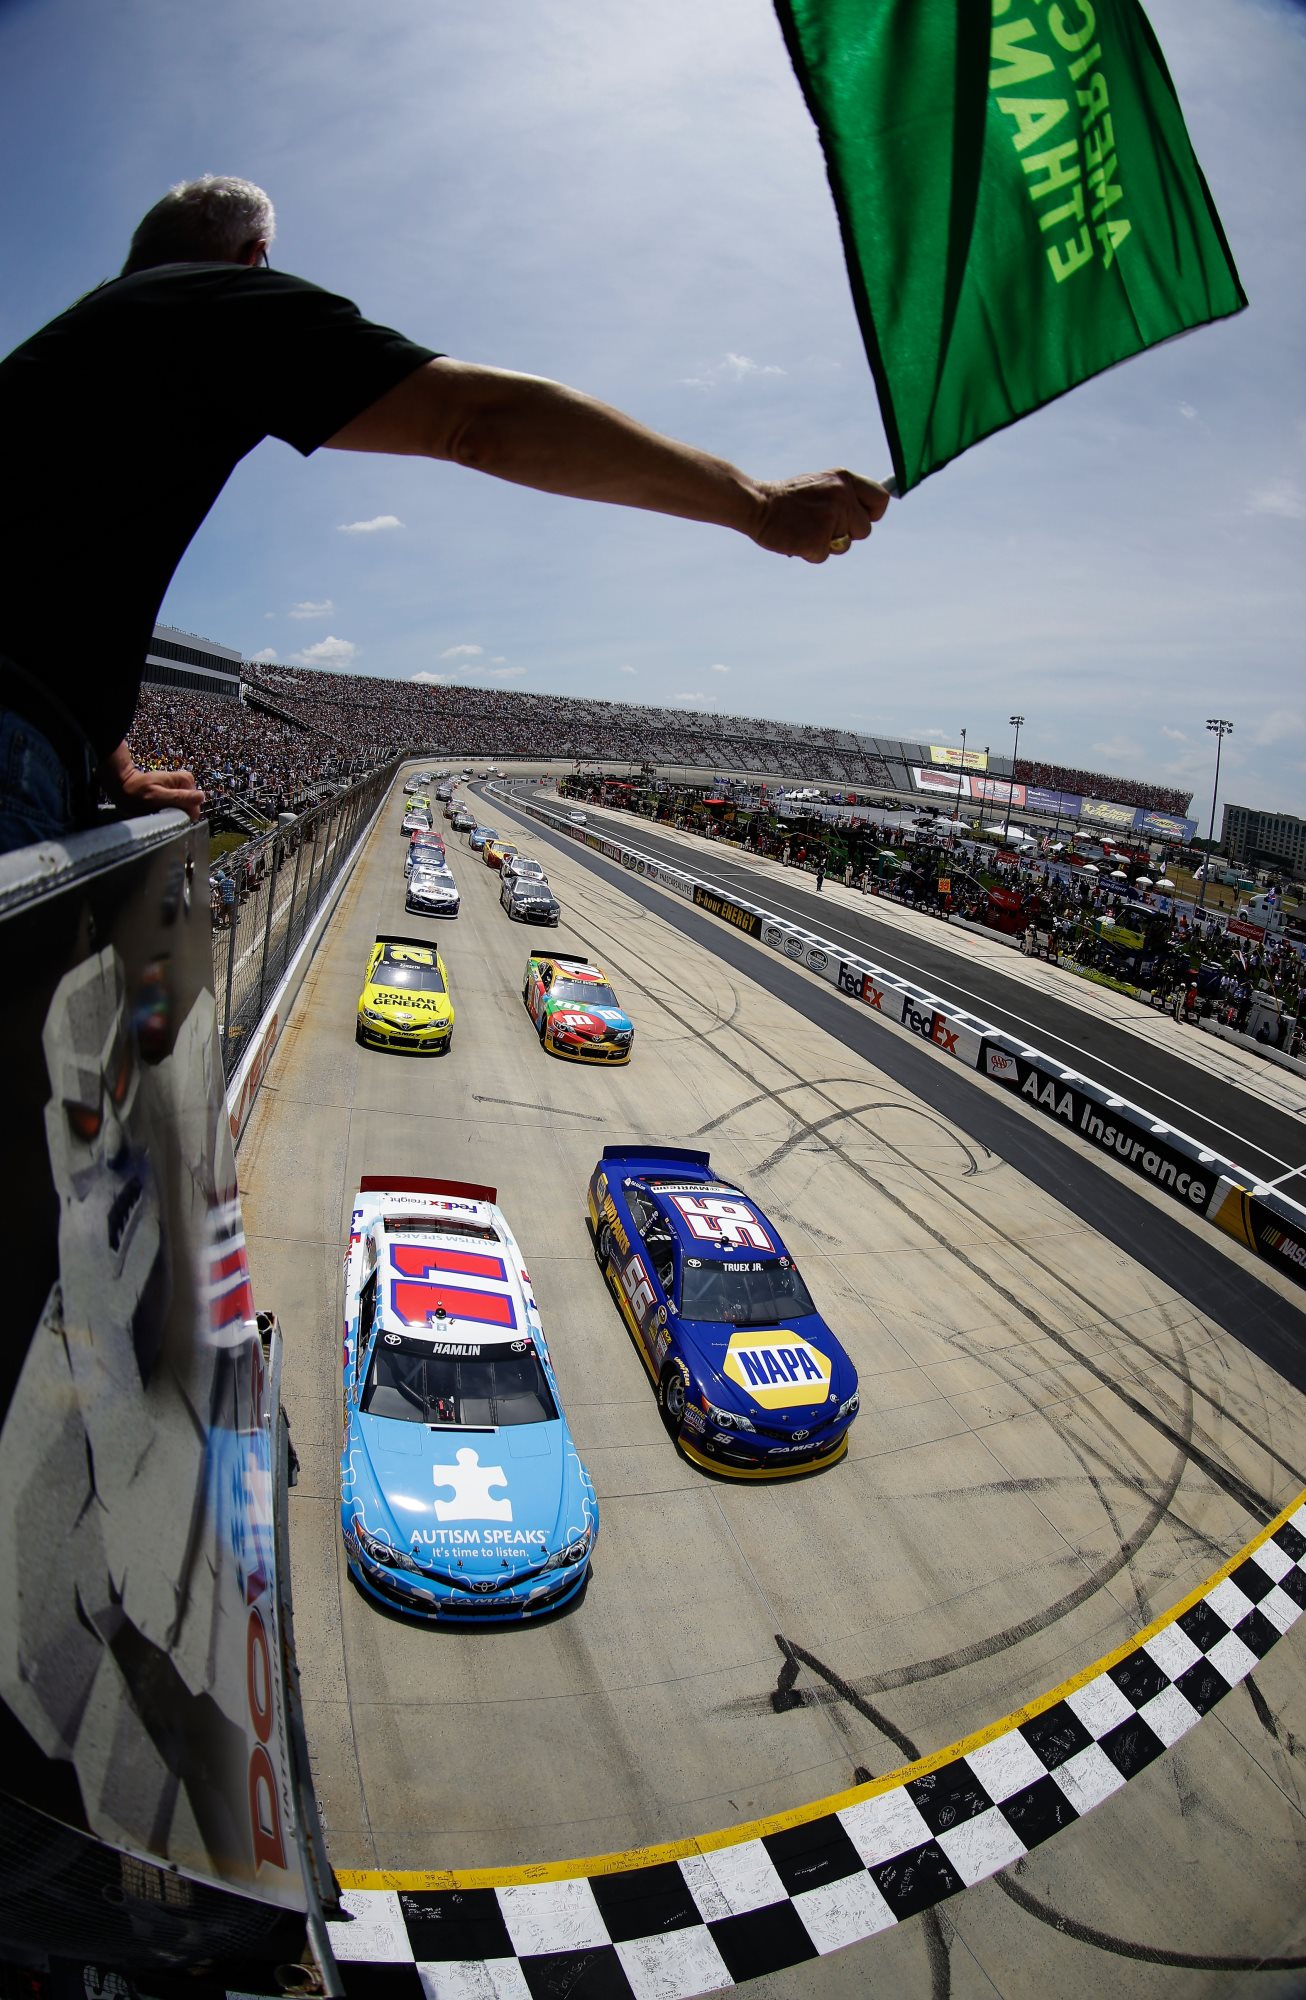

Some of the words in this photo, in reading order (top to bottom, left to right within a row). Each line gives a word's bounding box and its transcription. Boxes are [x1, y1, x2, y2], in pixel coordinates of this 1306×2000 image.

[695, 887, 722, 914] 5-hour
[720, 901, 756, 932] ENERGY
[838, 961, 885, 1009] FedEx
[373, 998, 440, 1012] GENERAL
[377, 992, 436, 1005] DOLLAR
[901, 995, 960, 1055] FedEx
[1021, 1071, 1074, 1122] AAA
[1081, 1103, 1207, 1205] Insurance
[389, 1196, 427, 1206] Freight
[429, 1199, 478, 1214] FedEx
[395, 1233, 444, 1241] SPEAKS
[446, 1236, 497, 1247] AUTISM
[610, 1216, 631, 1256] PARTS
[1279, 1237, 1306, 1269] NASC
[722, 1262, 751, 1272] TRUEX
[751, 1262, 764, 1272] JR.
[390, 1243, 518, 1330] 11
[618, 1252, 658, 1322] 56
[432, 1342, 481, 1357] HAMLIN
[737, 1347, 823, 1386] NAPA
[712, 1432, 734, 1446] 56
[767, 1440, 824, 1454] CAMRY
[410, 1529, 482, 1544] AUTISM
[483, 1529, 546, 1544] SPEAKS
[432, 1547, 449, 1558] It's
[451, 1547, 477, 1558] time
[480, 1547, 495, 1558] to
[495, 1547, 530, 1558] listen.
